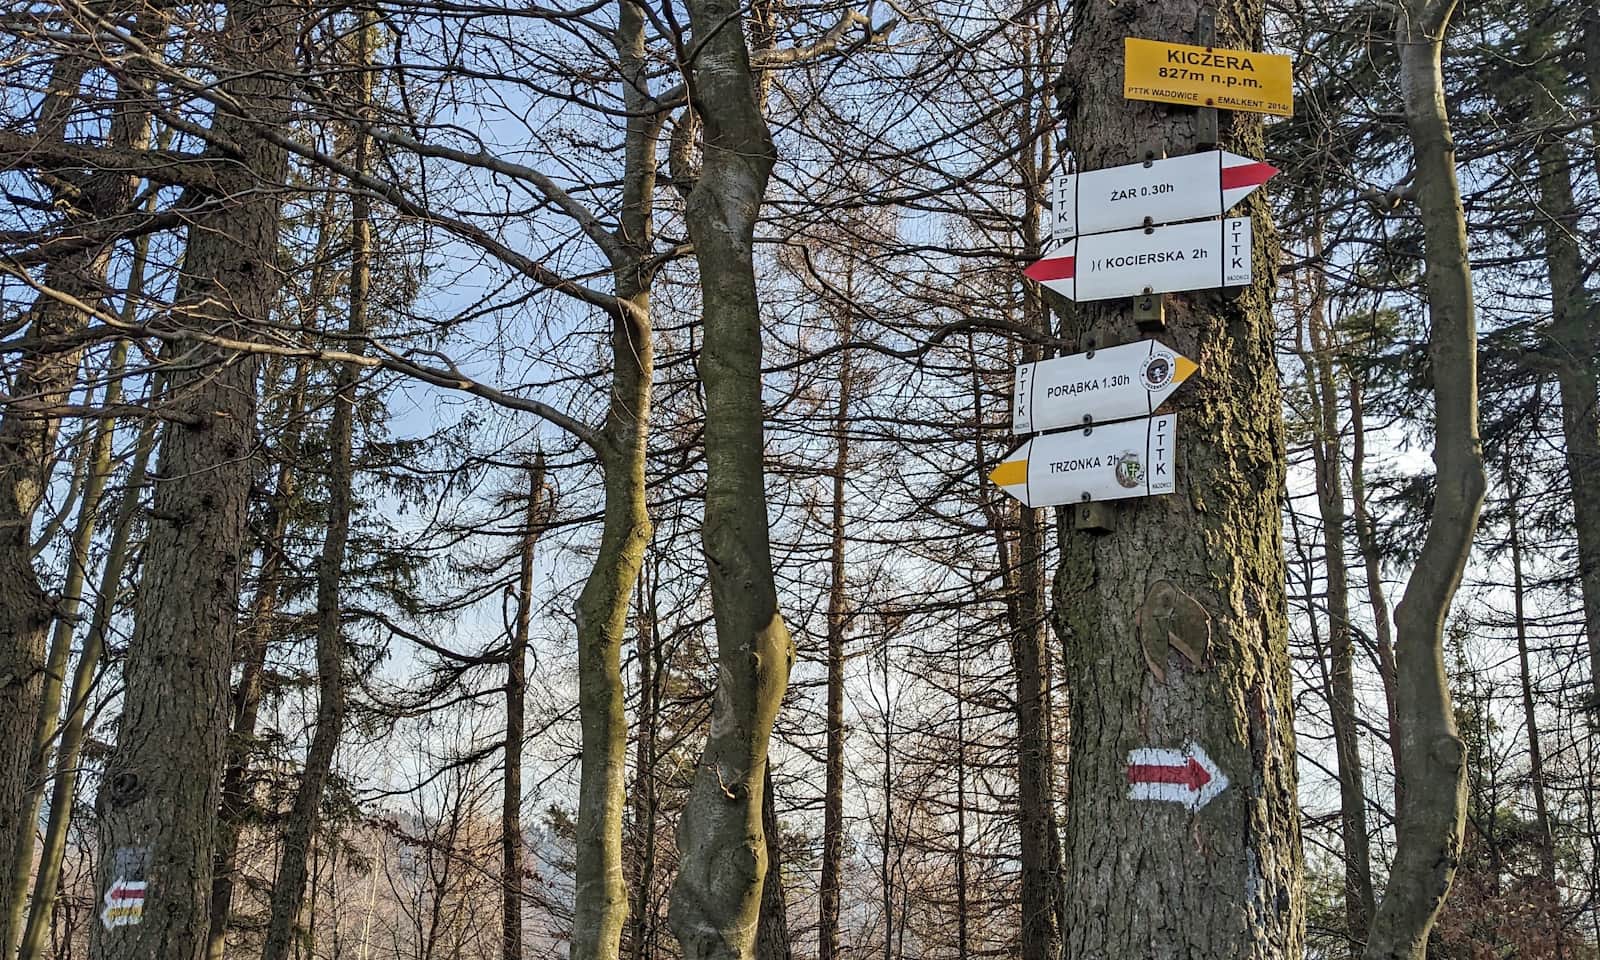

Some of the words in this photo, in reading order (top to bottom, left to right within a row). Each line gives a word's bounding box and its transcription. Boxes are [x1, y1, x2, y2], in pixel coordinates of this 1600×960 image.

[1168, 49, 1254, 71] KICZERA
[1159, 67, 1204, 81] 827m
[1211, 73, 1263, 88] n.p.m.
[1128, 87, 1150, 95] PTTK
[1151, 88, 1198, 101] WADOWICE
[1217, 96, 1264, 108] EMALKENT
[1110, 188, 1137, 202] ŻAR
[1141, 183, 1174, 196] 0.30h
[1106, 250, 1185, 269] KOCIERSKA
[1192, 248, 1208, 259] 2h
[1047, 379, 1099, 399] PORĄBKA
[1102, 374, 1130, 389] 1.30h
[1049, 457, 1101, 474] TRZONKA
